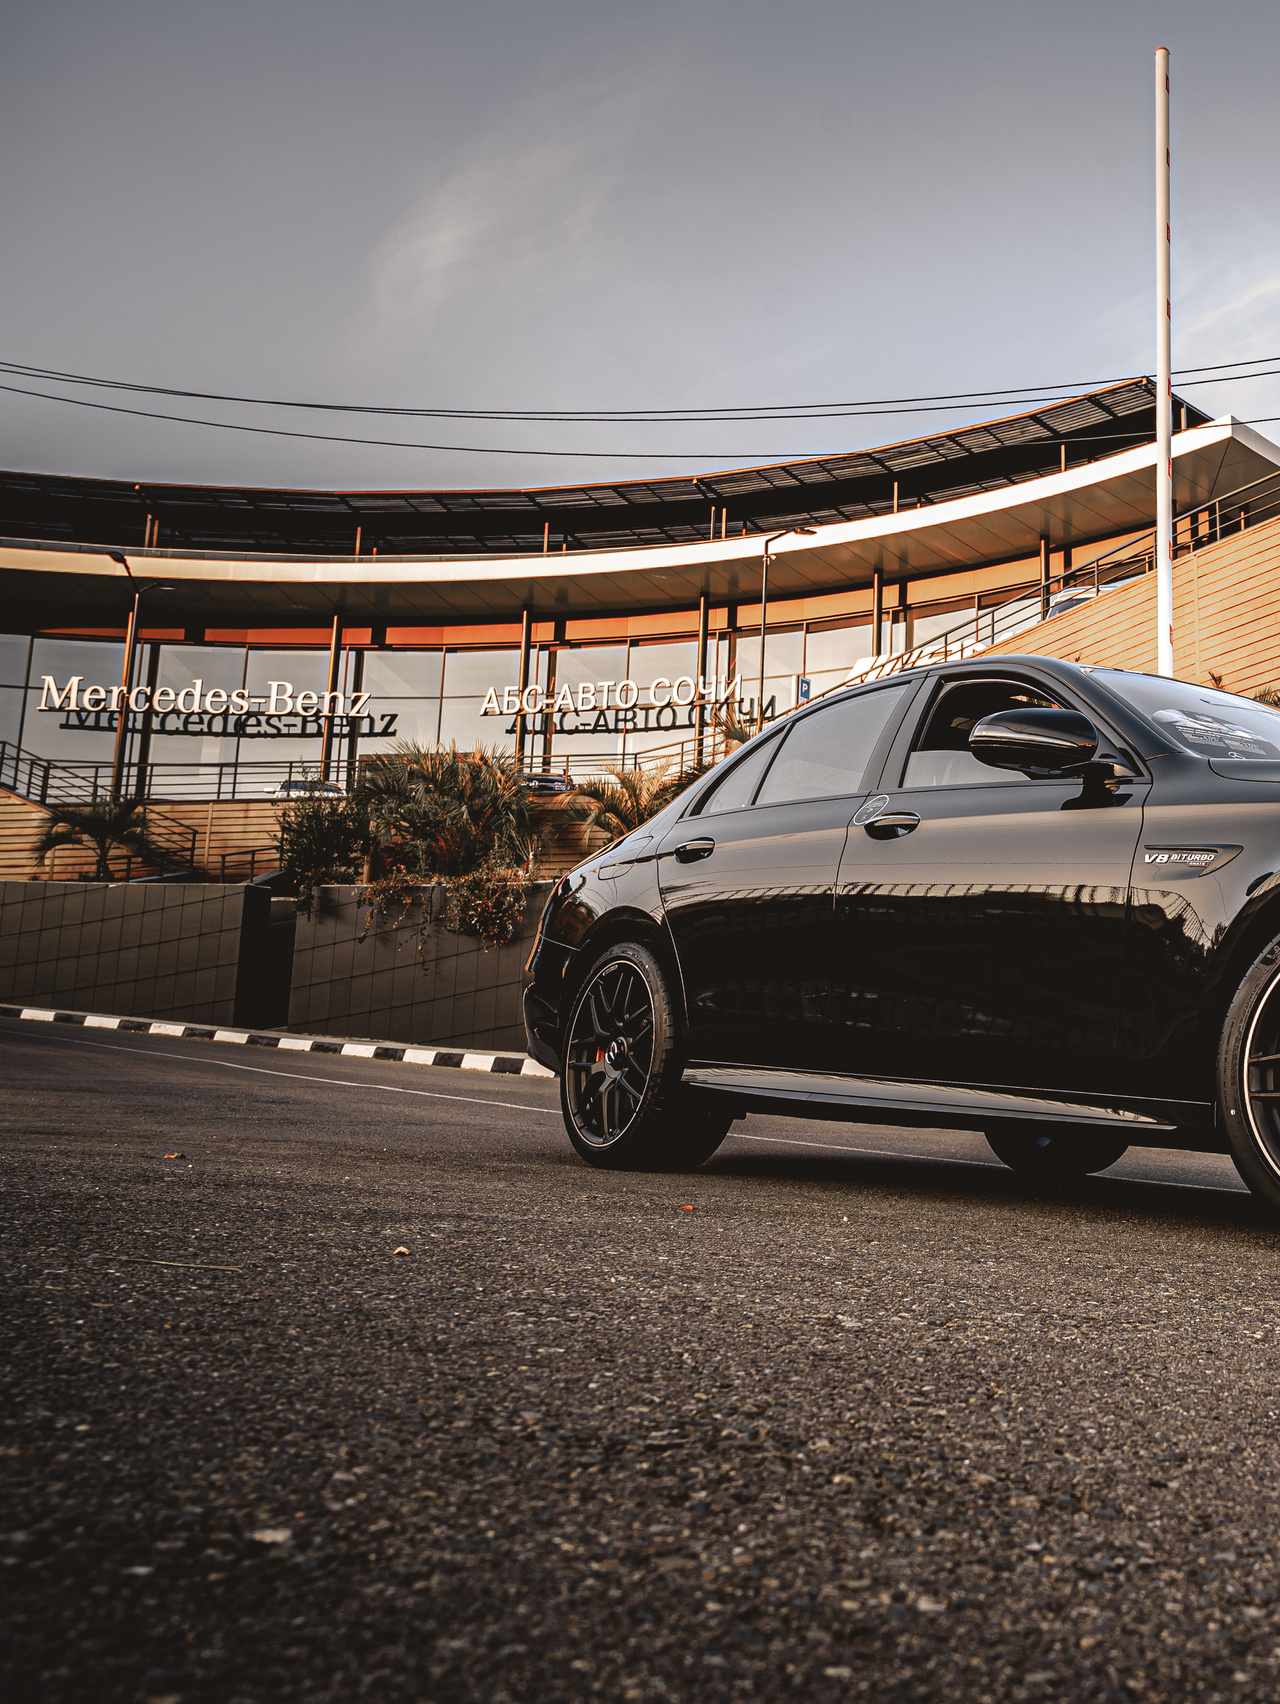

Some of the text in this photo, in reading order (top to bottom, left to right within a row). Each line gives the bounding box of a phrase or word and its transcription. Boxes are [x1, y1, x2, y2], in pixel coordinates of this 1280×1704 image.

[37, 675, 372, 718] Mercedes-Benz
[480, 674, 743, 716] АБС-АВТО СОЧИ
[1144, 853, 1215, 864] V8 BITURBO
